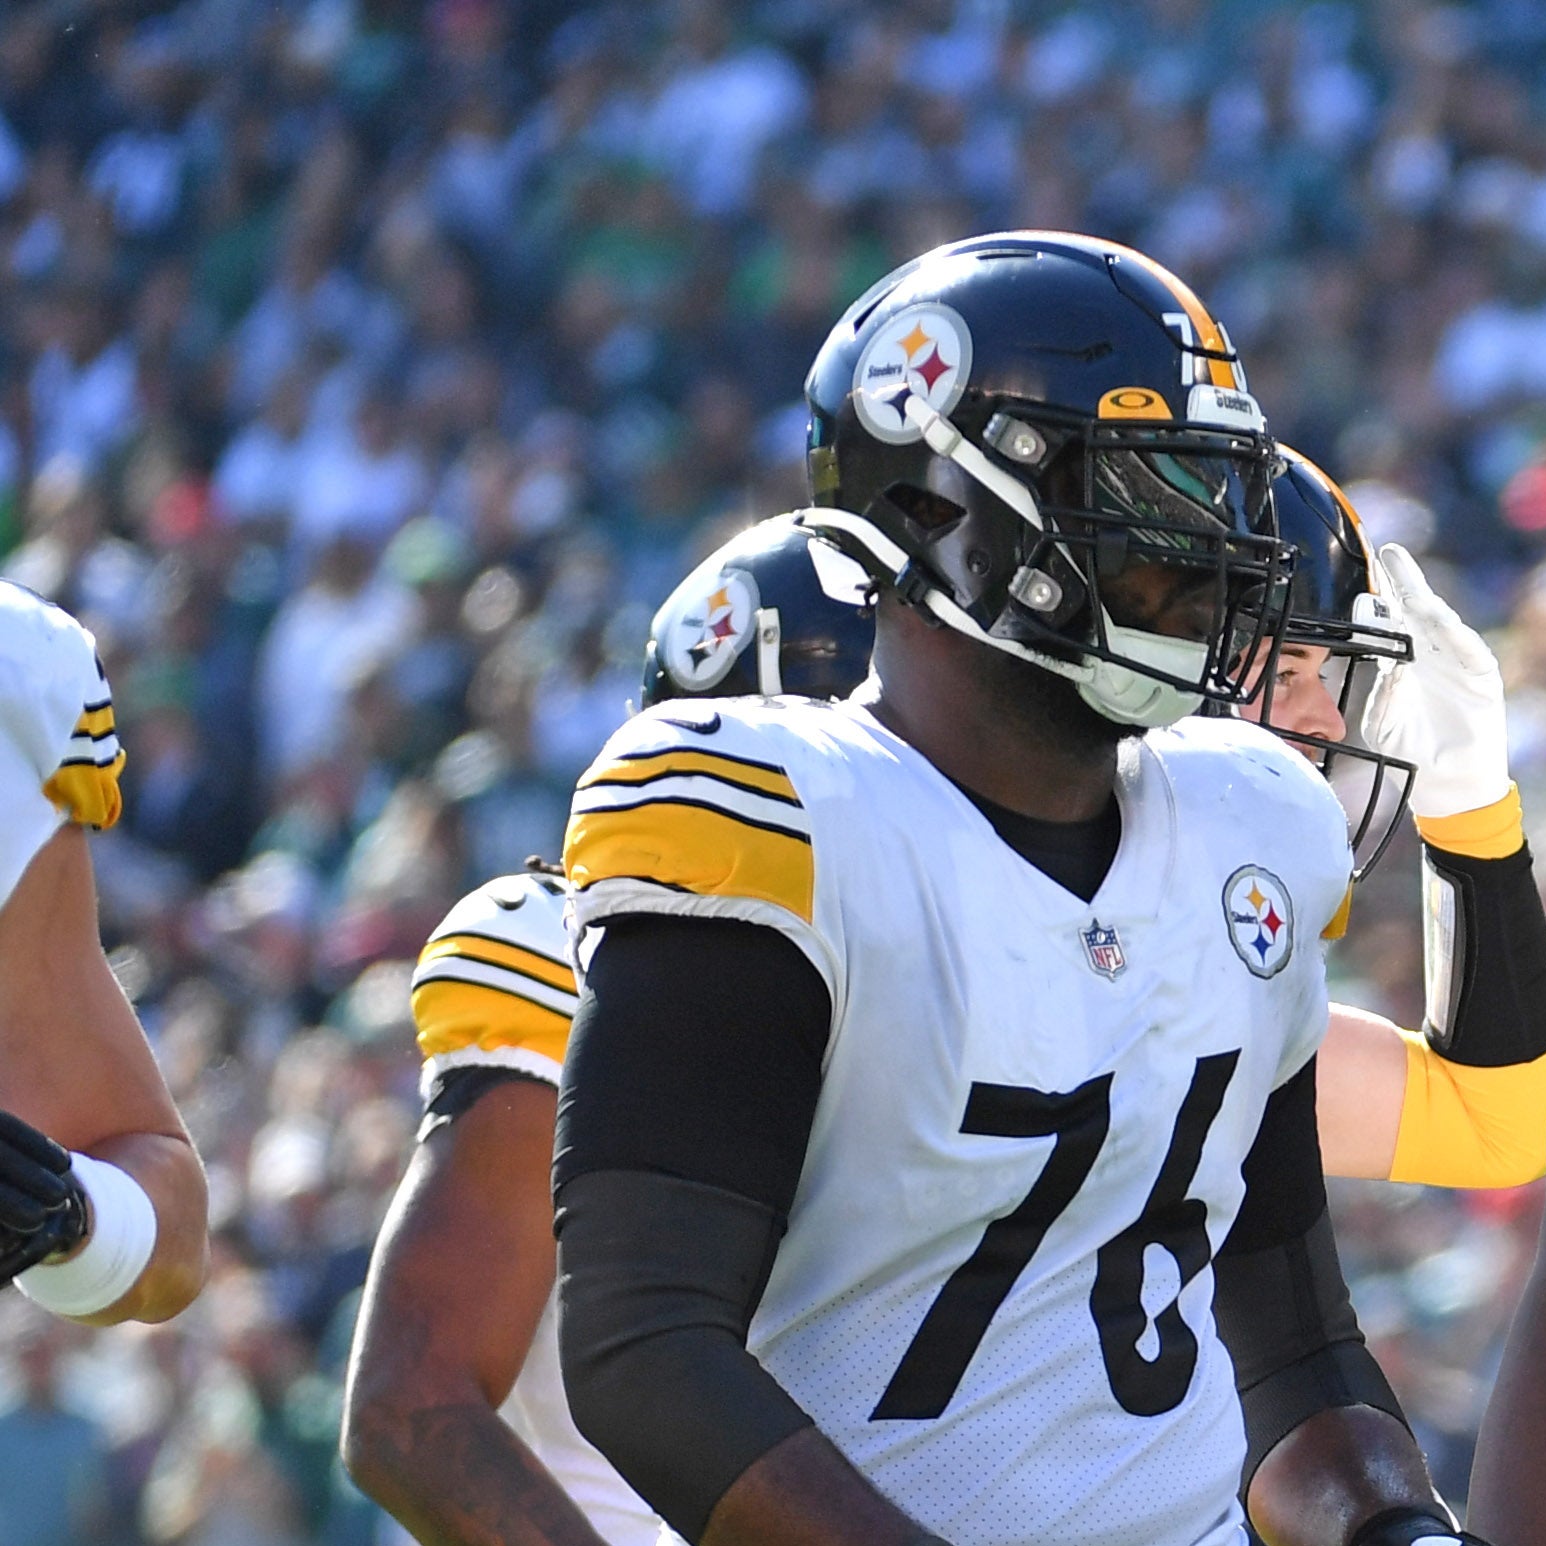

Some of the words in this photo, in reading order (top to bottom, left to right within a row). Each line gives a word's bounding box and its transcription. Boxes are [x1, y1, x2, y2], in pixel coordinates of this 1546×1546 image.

[868, 361, 903, 379] Steelers
[1093, 947, 1123, 970] NFL
[868, 1047, 1242, 1422] 76
